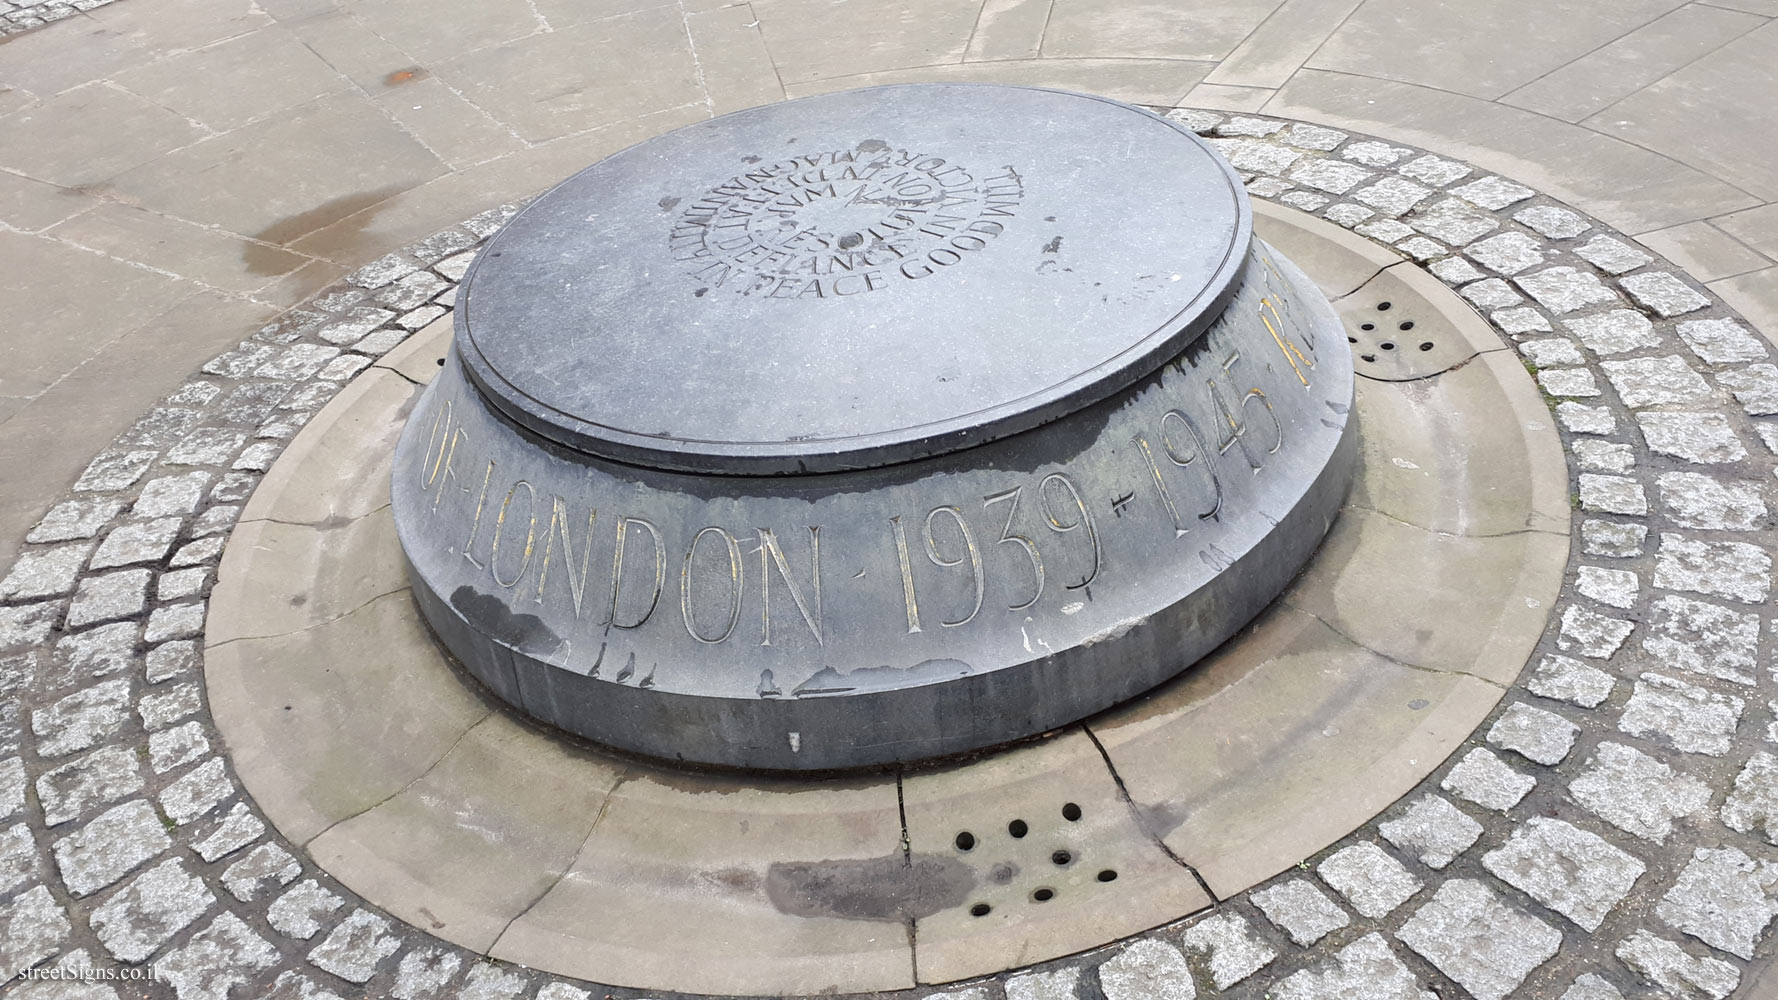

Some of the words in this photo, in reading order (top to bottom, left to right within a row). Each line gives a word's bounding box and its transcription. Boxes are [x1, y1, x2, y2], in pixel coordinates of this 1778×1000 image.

[841, 166, 887, 181] IN
[868, 148, 978, 210] VICTORY
[669, 150, 862, 261] MAGNANIMITY
[713, 168, 828, 231] DEFEAT
[755, 171, 934, 252] RESOLUTION
[757, 184, 836, 221] WAR
[919, 214, 966, 238] IN
[687, 261, 745, 288] IN
[712, 234, 917, 275] DEFIANCE
[736, 270, 888, 298] PEACE
[421, 400, 468, 515] OF
[463, 457, 824, 648] LONDON
